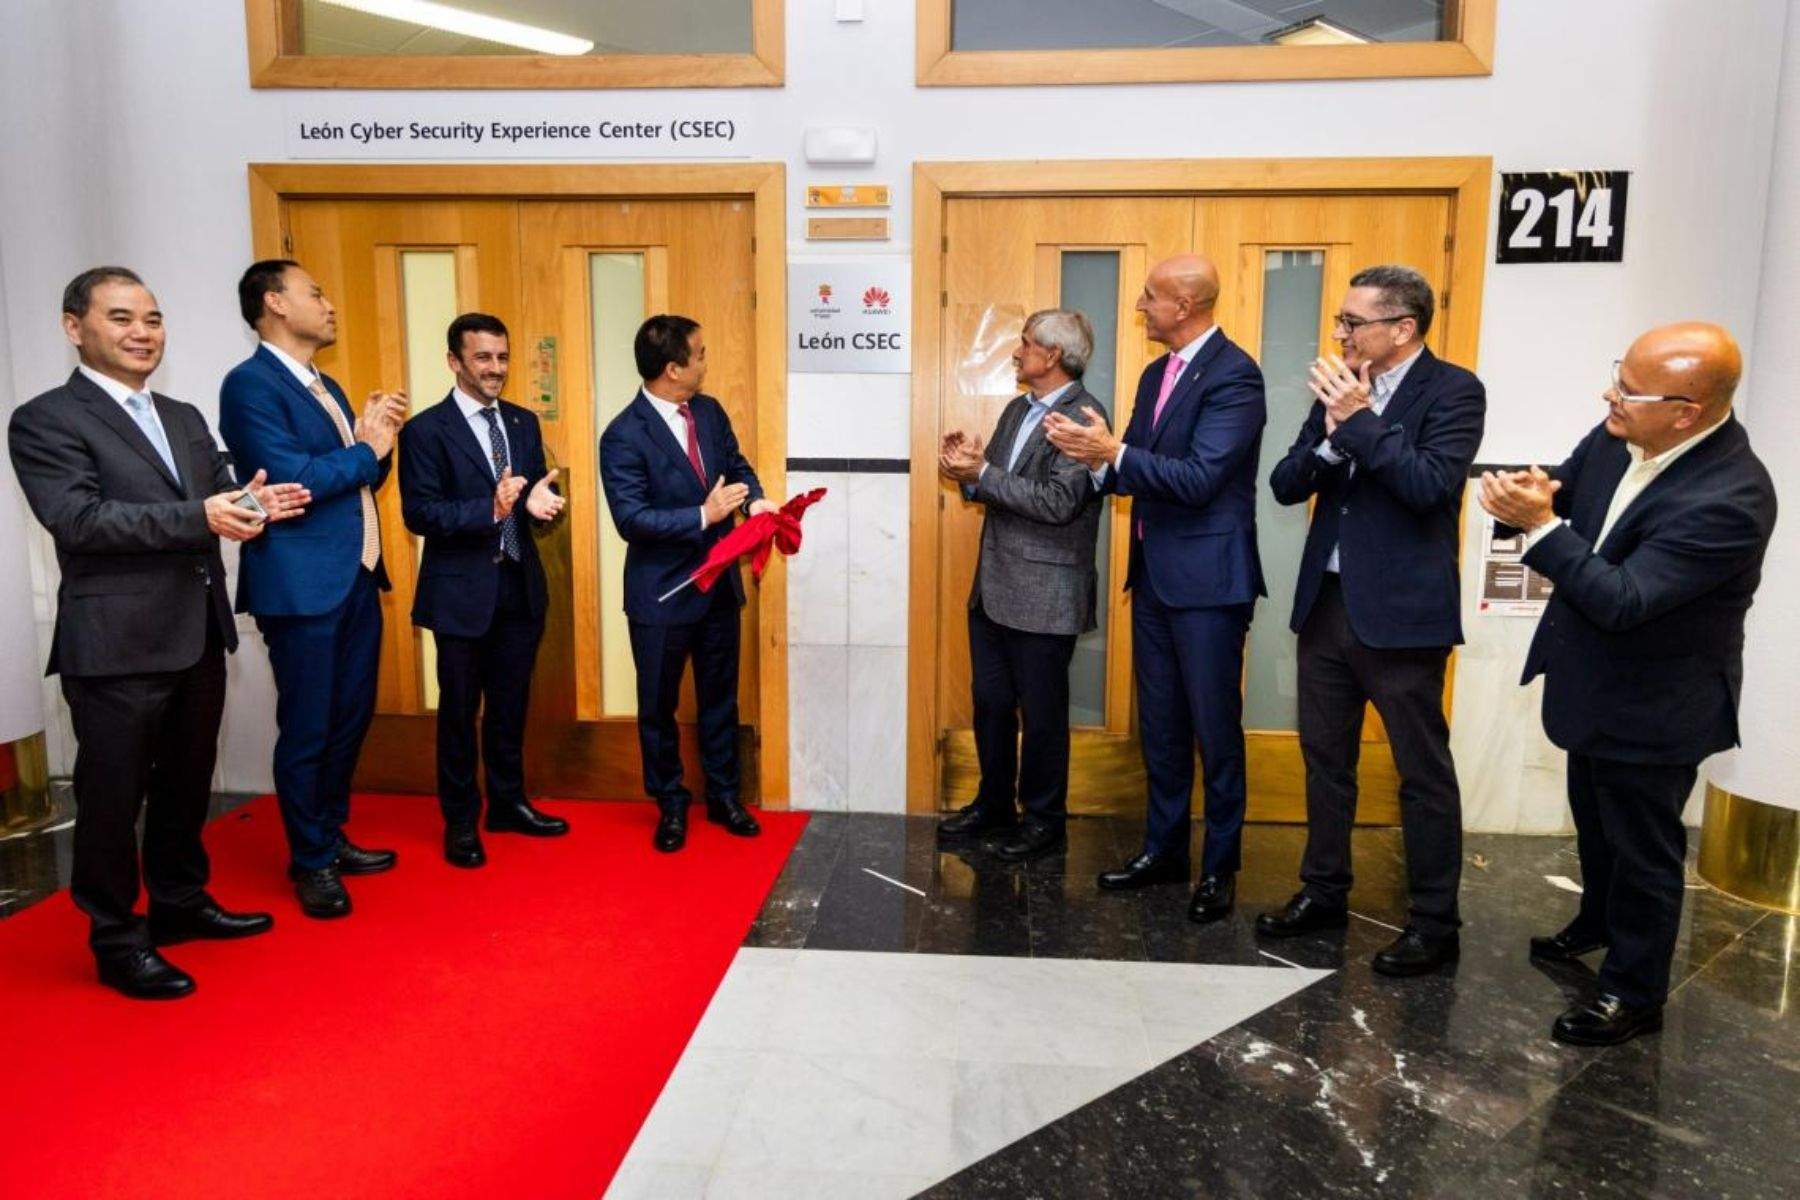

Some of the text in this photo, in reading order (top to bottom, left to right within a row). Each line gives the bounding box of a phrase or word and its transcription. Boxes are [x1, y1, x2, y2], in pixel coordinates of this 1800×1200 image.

[300, 119, 736, 144] León Cyber Security Experience Center (CSEC)
[1508, 188, 1613, 248] 214
[798, 331, 902, 350] León CSEC
